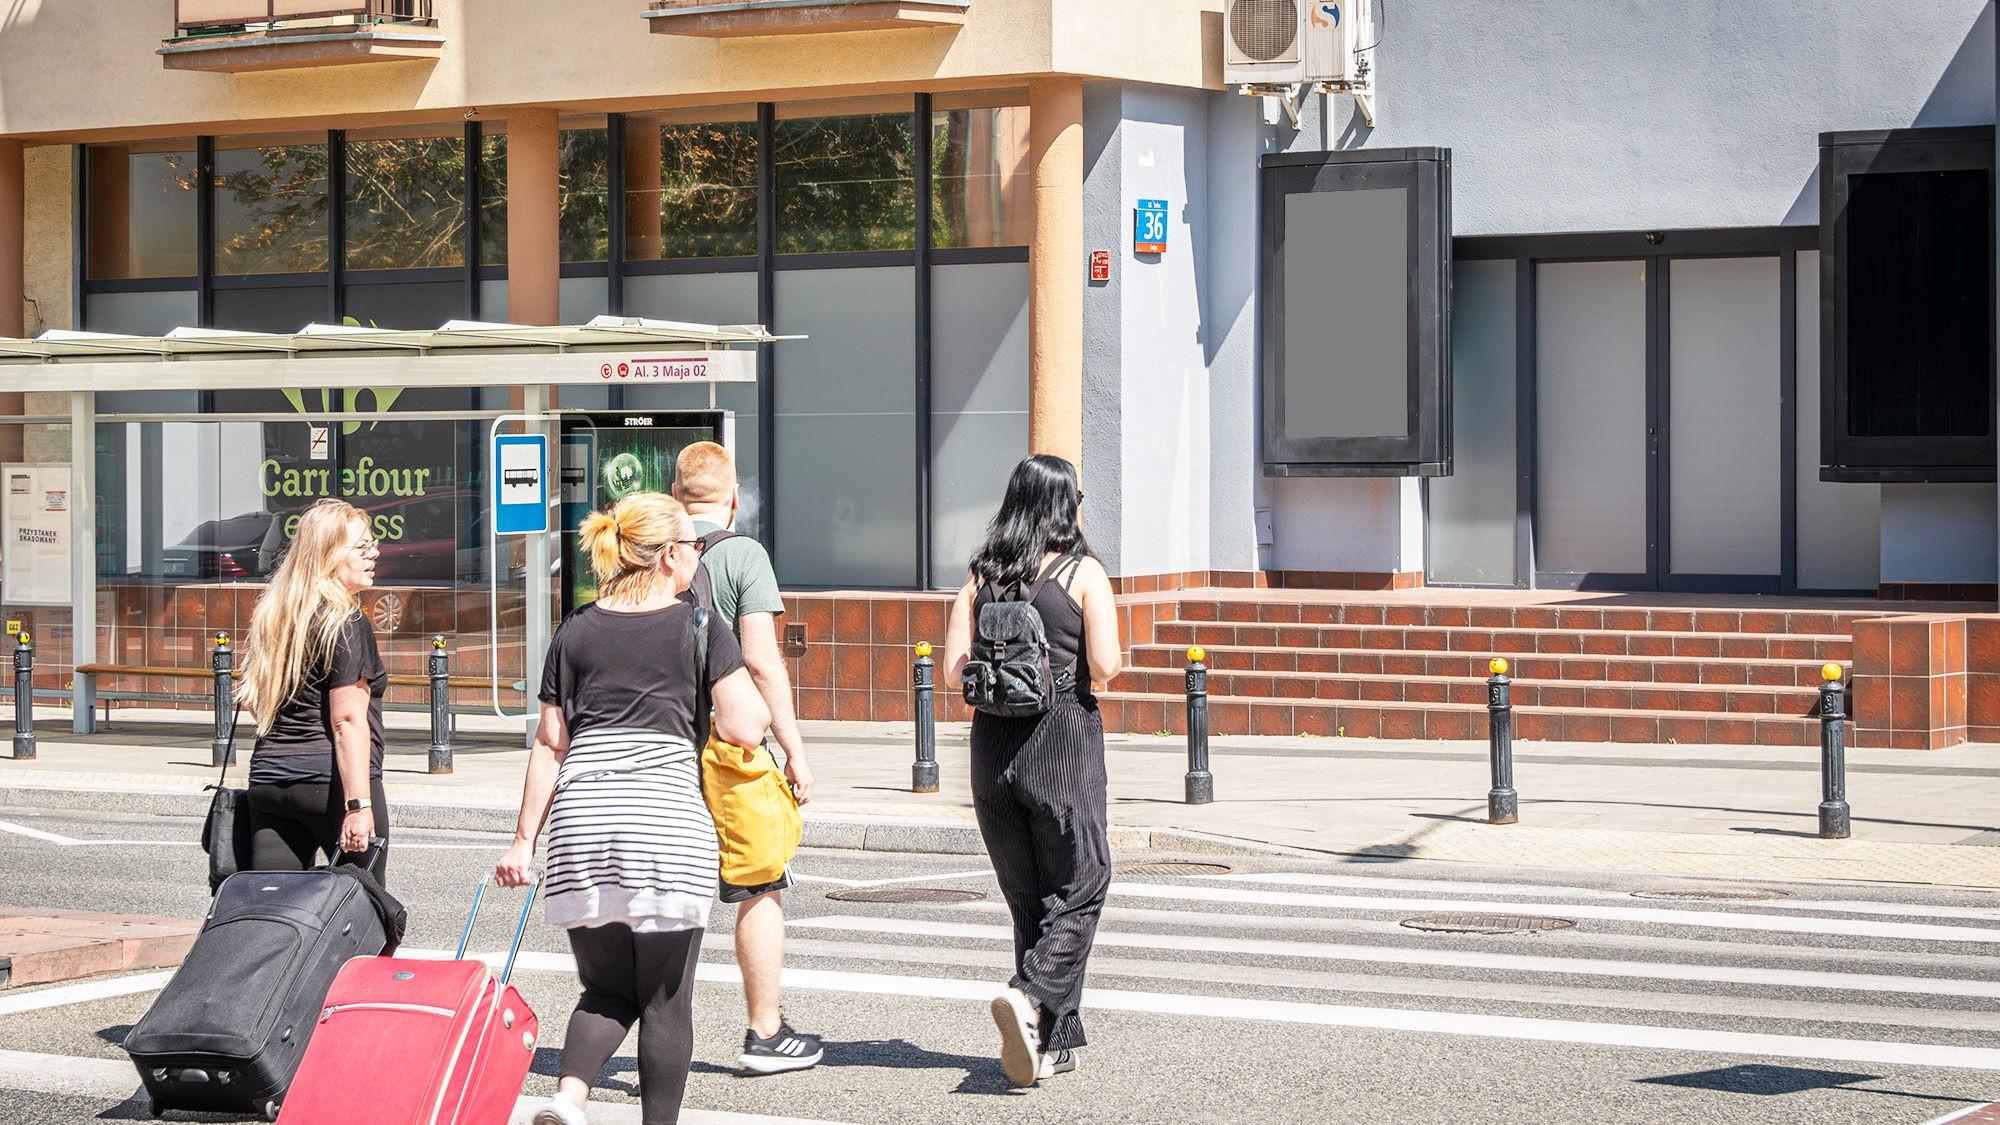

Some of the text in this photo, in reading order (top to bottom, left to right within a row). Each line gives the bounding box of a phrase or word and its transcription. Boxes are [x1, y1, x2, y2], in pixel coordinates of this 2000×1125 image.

[1143, 211, 1164, 240] 36
[634, 364, 707, 380] Al. 3 Maja 02
[259, 456, 430, 497] Carrefour
[18, 528, 58, 537] PRZYSTANEK
[19, 535, 56, 544] SKASOWANY
